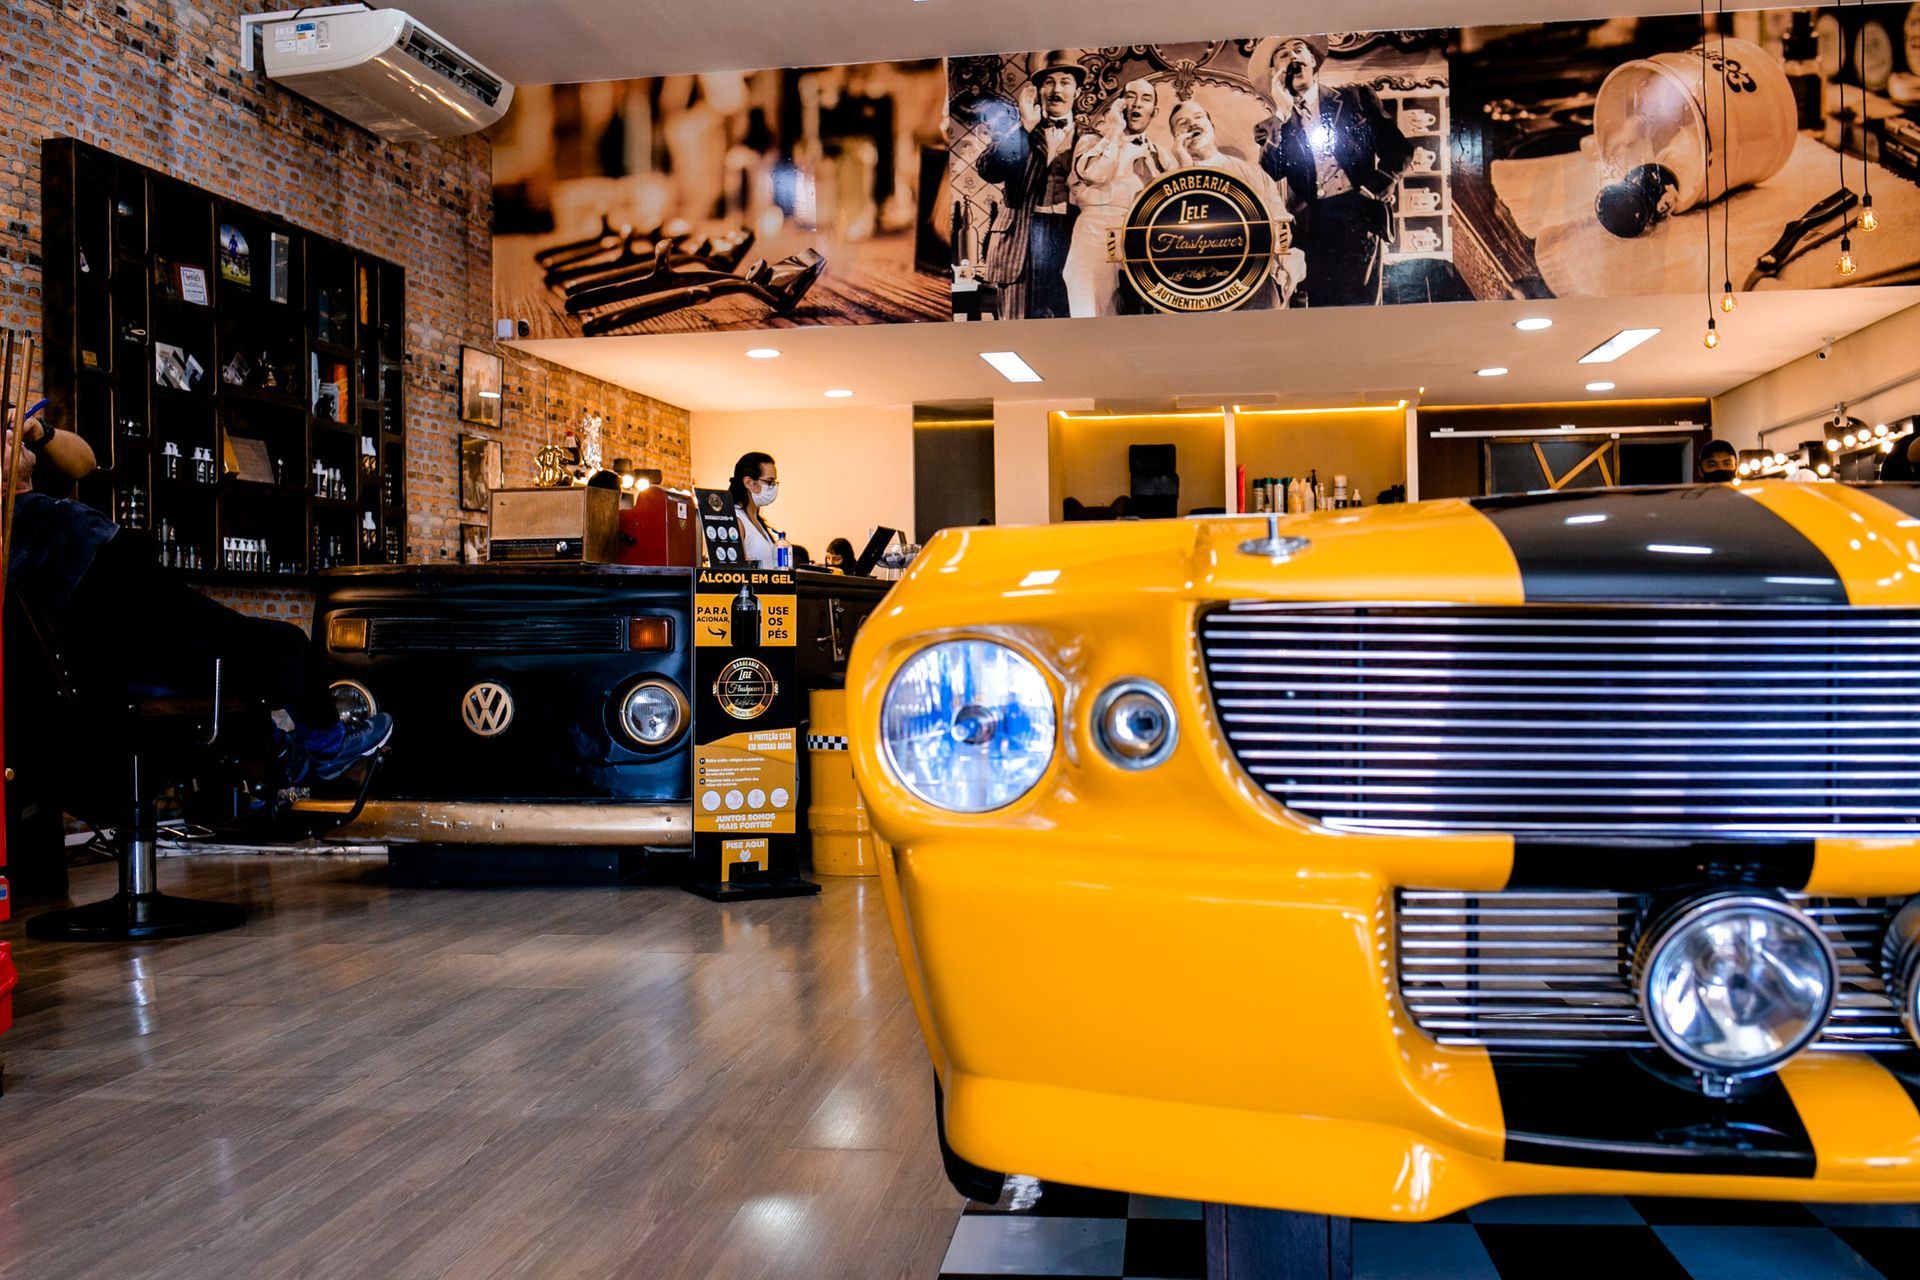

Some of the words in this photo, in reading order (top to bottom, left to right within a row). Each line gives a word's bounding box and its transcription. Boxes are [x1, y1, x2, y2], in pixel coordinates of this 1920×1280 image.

[1163, 175, 1230, 197] BARBEARIA
[1151, 233, 1244, 254] Flashpower
[1155, 286, 1204, 309] AUTHENTIC
[1205, 283, 1243, 308] VINTAGE
[699, 570, 749, 584] ÁLCOOL
[751, 574, 769, 584] EM
[771, 574, 794, 584] GEL
[697, 607, 728, 615] PARA
[768, 607, 789, 615] USE
[768, 617, 783, 626] OS
[768, 628, 788, 639] PÉS
[715, 814, 746, 823] JUNTOS
[747, 812, 776, 821] SOMOS
[725, 841, 744, 849] PISE
[745, 840, 765, 848] AQUI
